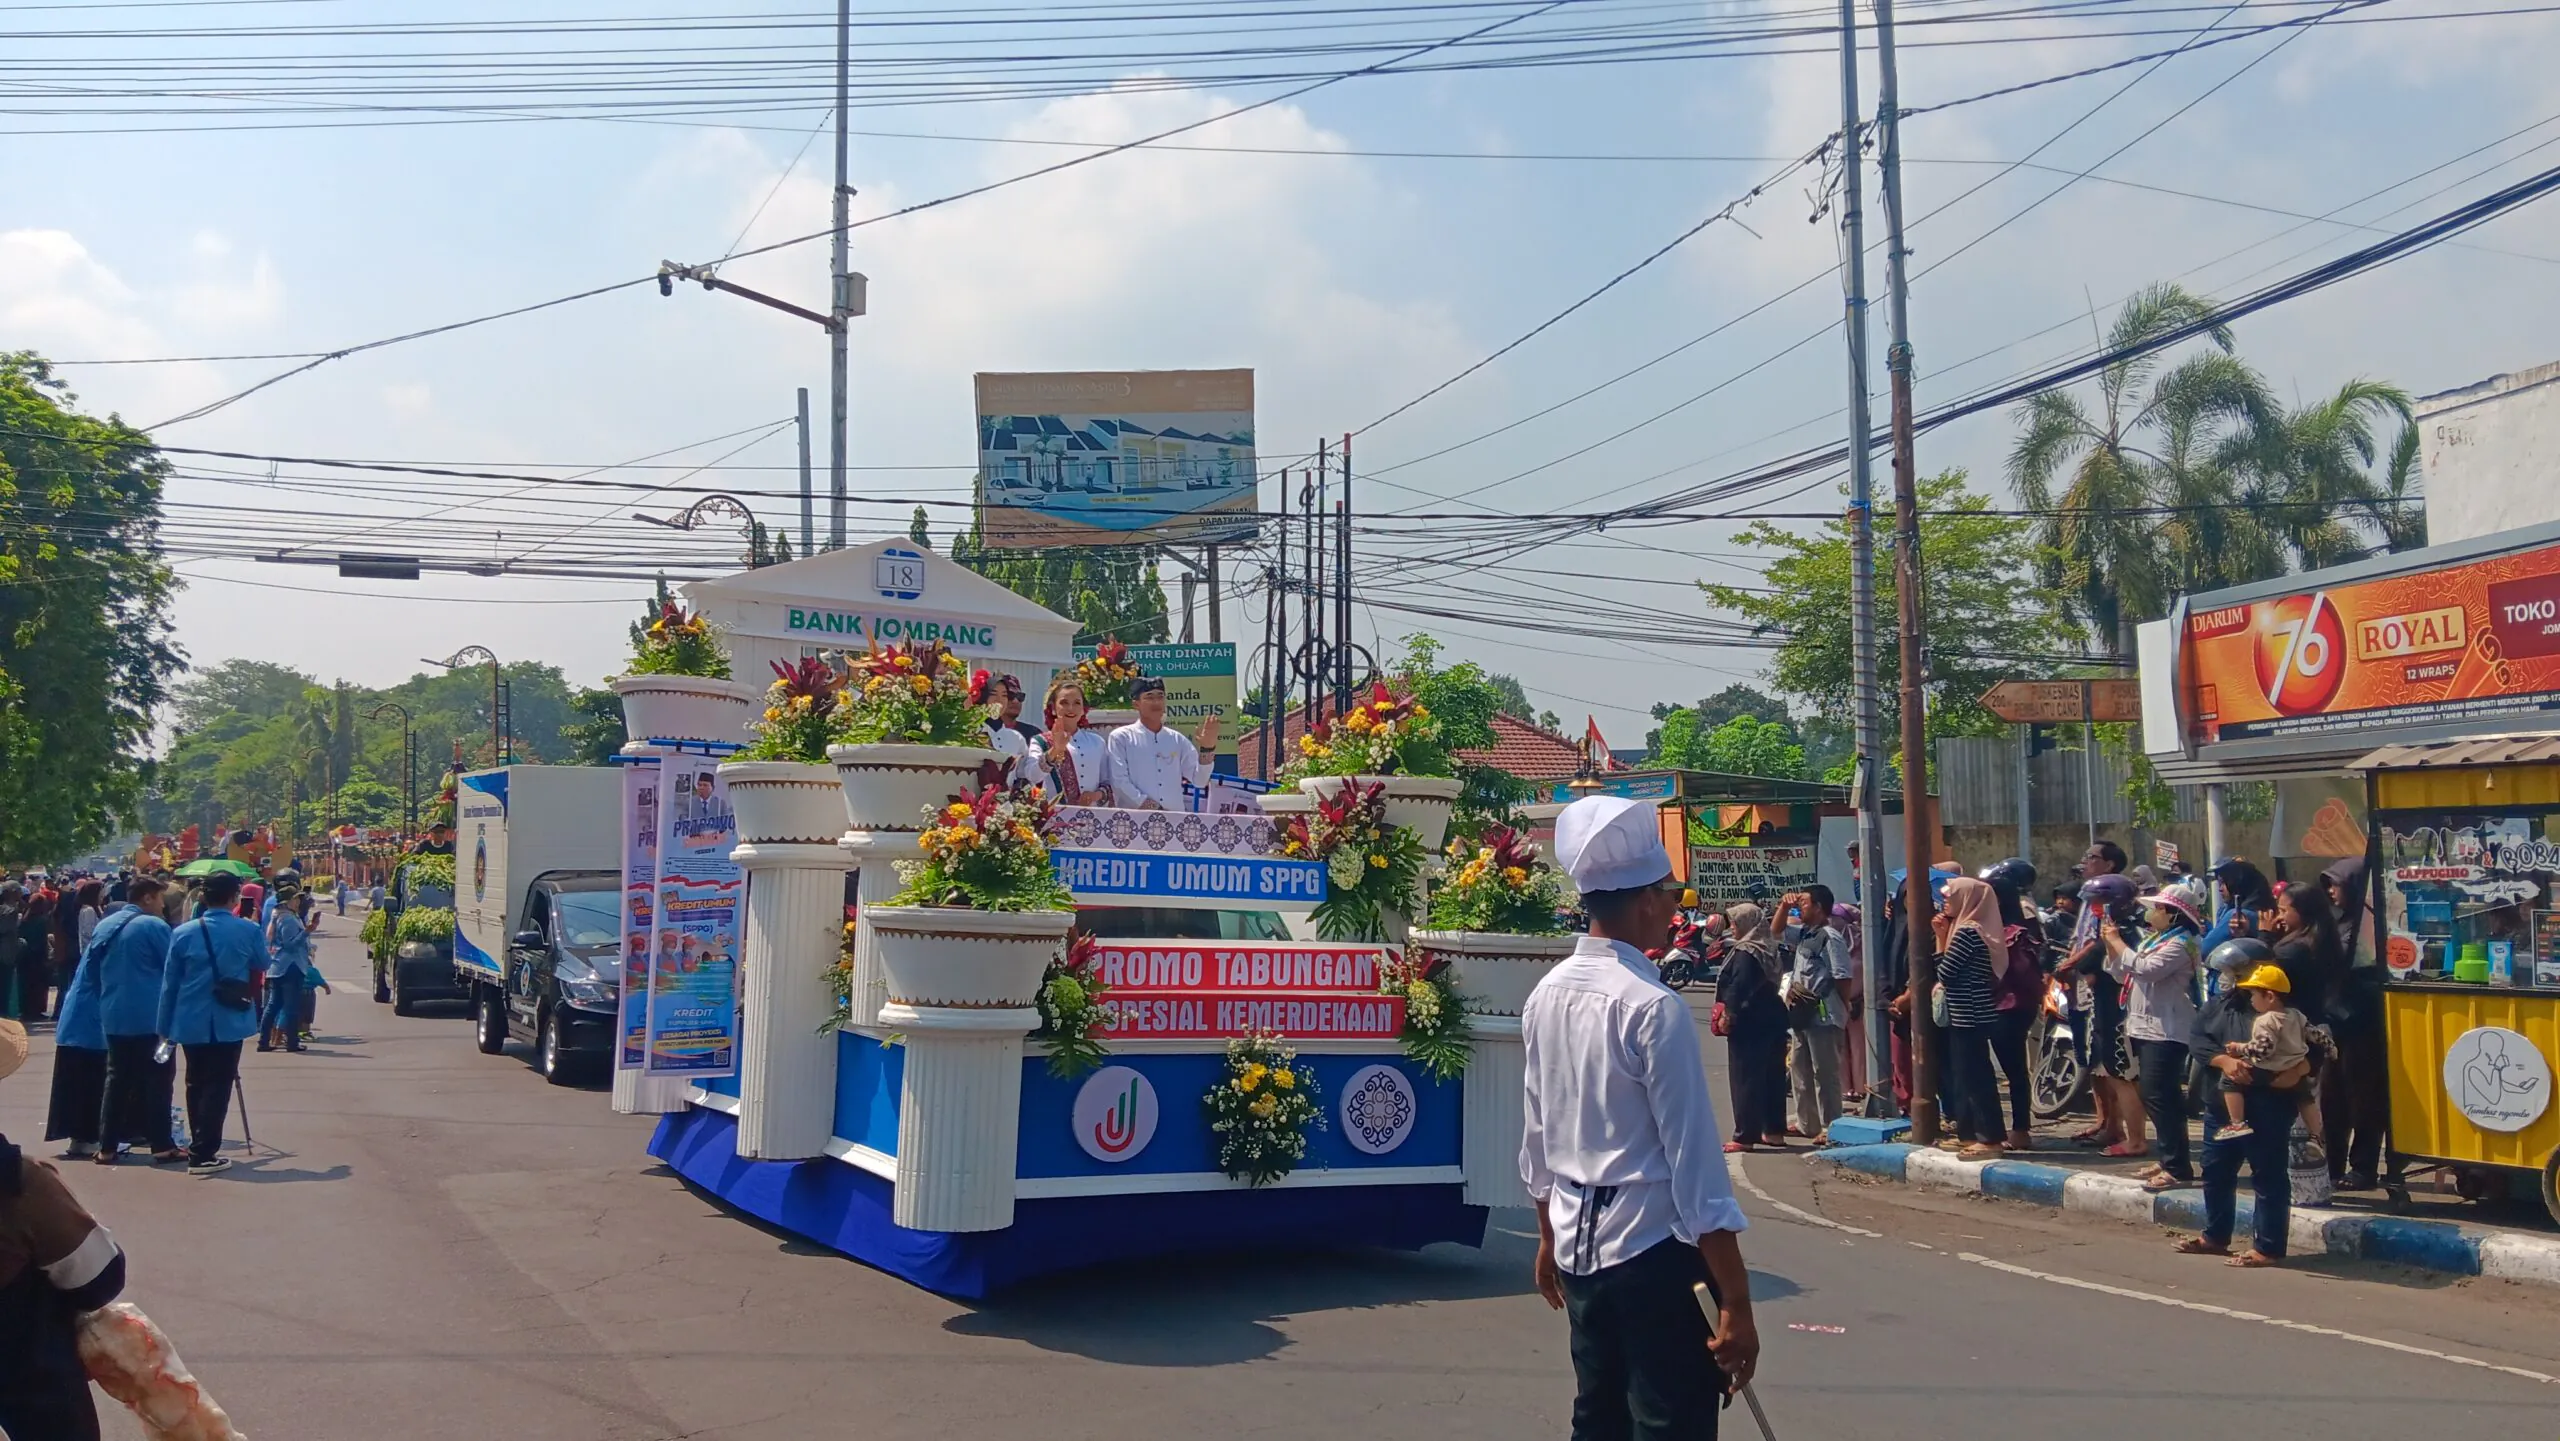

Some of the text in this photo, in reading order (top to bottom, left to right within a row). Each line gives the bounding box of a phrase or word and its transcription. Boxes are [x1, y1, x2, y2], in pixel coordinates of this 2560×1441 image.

[889, 565, 914, 588] 18
[2503, 599, 2556, 624] TOKO
[789, 608, 994, 647] BANK JOMBANG
[2193, 607, 2245, 633] DJARUM
[2364, 614, 2460, 653] ROYAL
[2541, 622, 2560, 636] JOM
[1175, 647, 1233, 660] DINIYAH
[2269, 591, 2329, 707] 76
[1155, 663, 1164, 671] &
[2406, 664, 2456, 680] 12 WRAPS
[1166, 688, 1200, 701] anda
[1166, 703, 1231, 718] NNAFIS"
[1695, 848, 1727, 862] Warung
[1727, 848, 1760, 860] POJOK
[2482, 842, 2560, 870] & BOBA
[1698, 862, 1735, 874] LONTONG
[1737, 861, 1760, 874] KIKIL
[1058, 856, 1320, 896] KREDIT UMUM SPPG
[1698, 875, 1717, 887] NASI
[1718, 874, 1740, 886] PECEL
[1699, 887, 1719, 899] NASI
[682, 924, 714, 934] (SPPG)
[1214, 951, 1374, 987] TABUNGAN
[673, 1007, 714, 1018] KREDIT
[1104, 1000, 1393, 1033] SPESIAL KEMERDEKAAN
